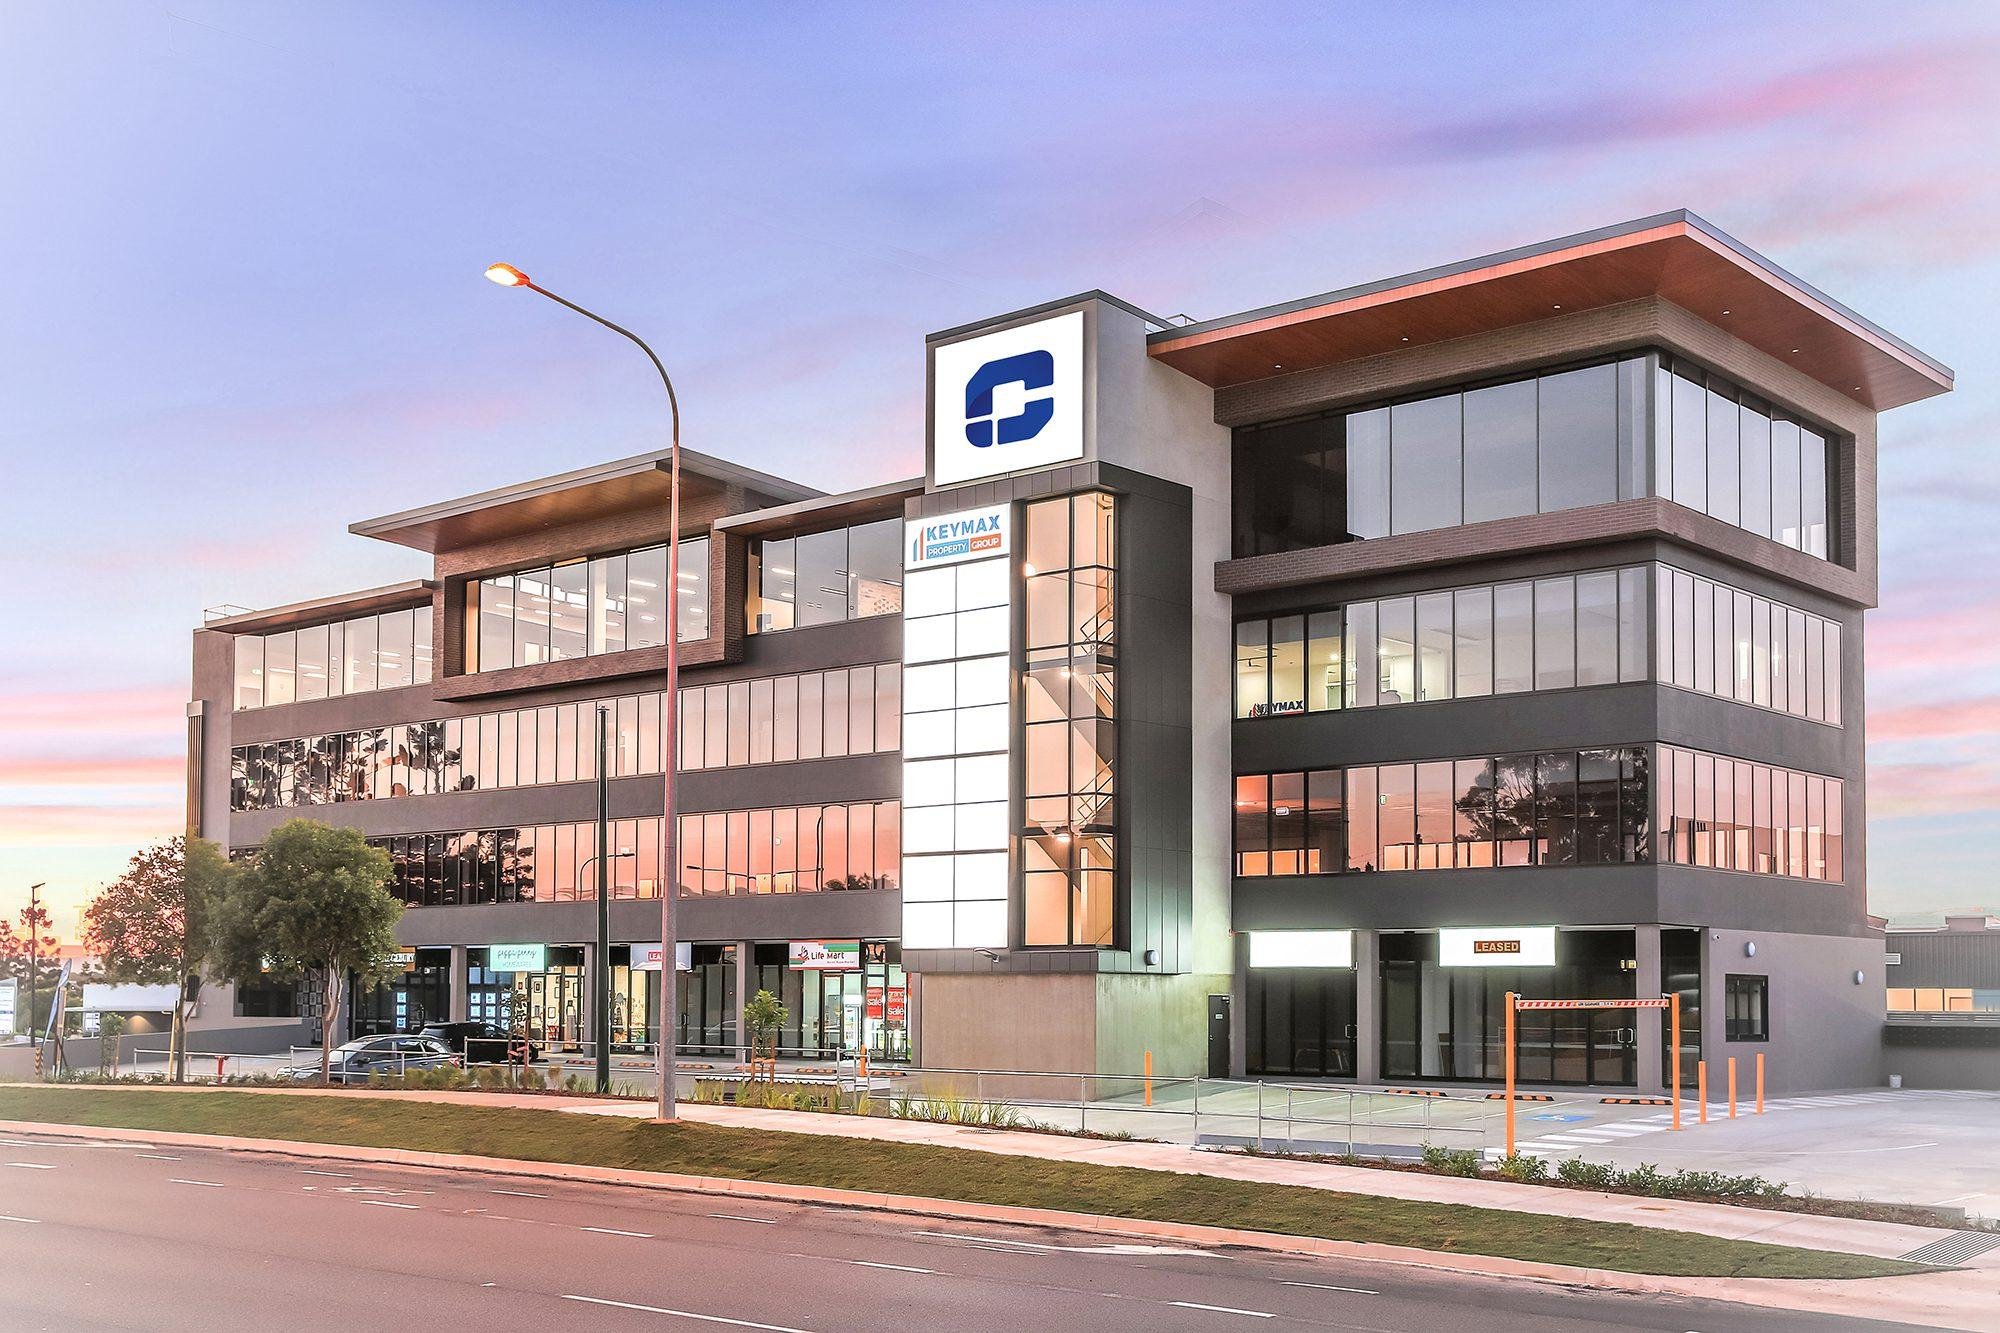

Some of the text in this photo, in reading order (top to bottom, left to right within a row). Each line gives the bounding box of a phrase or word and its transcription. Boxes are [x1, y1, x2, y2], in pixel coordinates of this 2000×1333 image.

[926, 515, 1000, 541] KEYMAX
[928, 538, 999, 557] PROPERTY GROUP
[1258, 701, 1303, 714] YMAX
[1475, 942, 1519, 952] LEASED
[650, 952, 662, 960] LEA
[811, 952, 845, 960] Life Mart
[867, 997, 882, 1006] sale
[887, 1006, 904, 1015] sale
